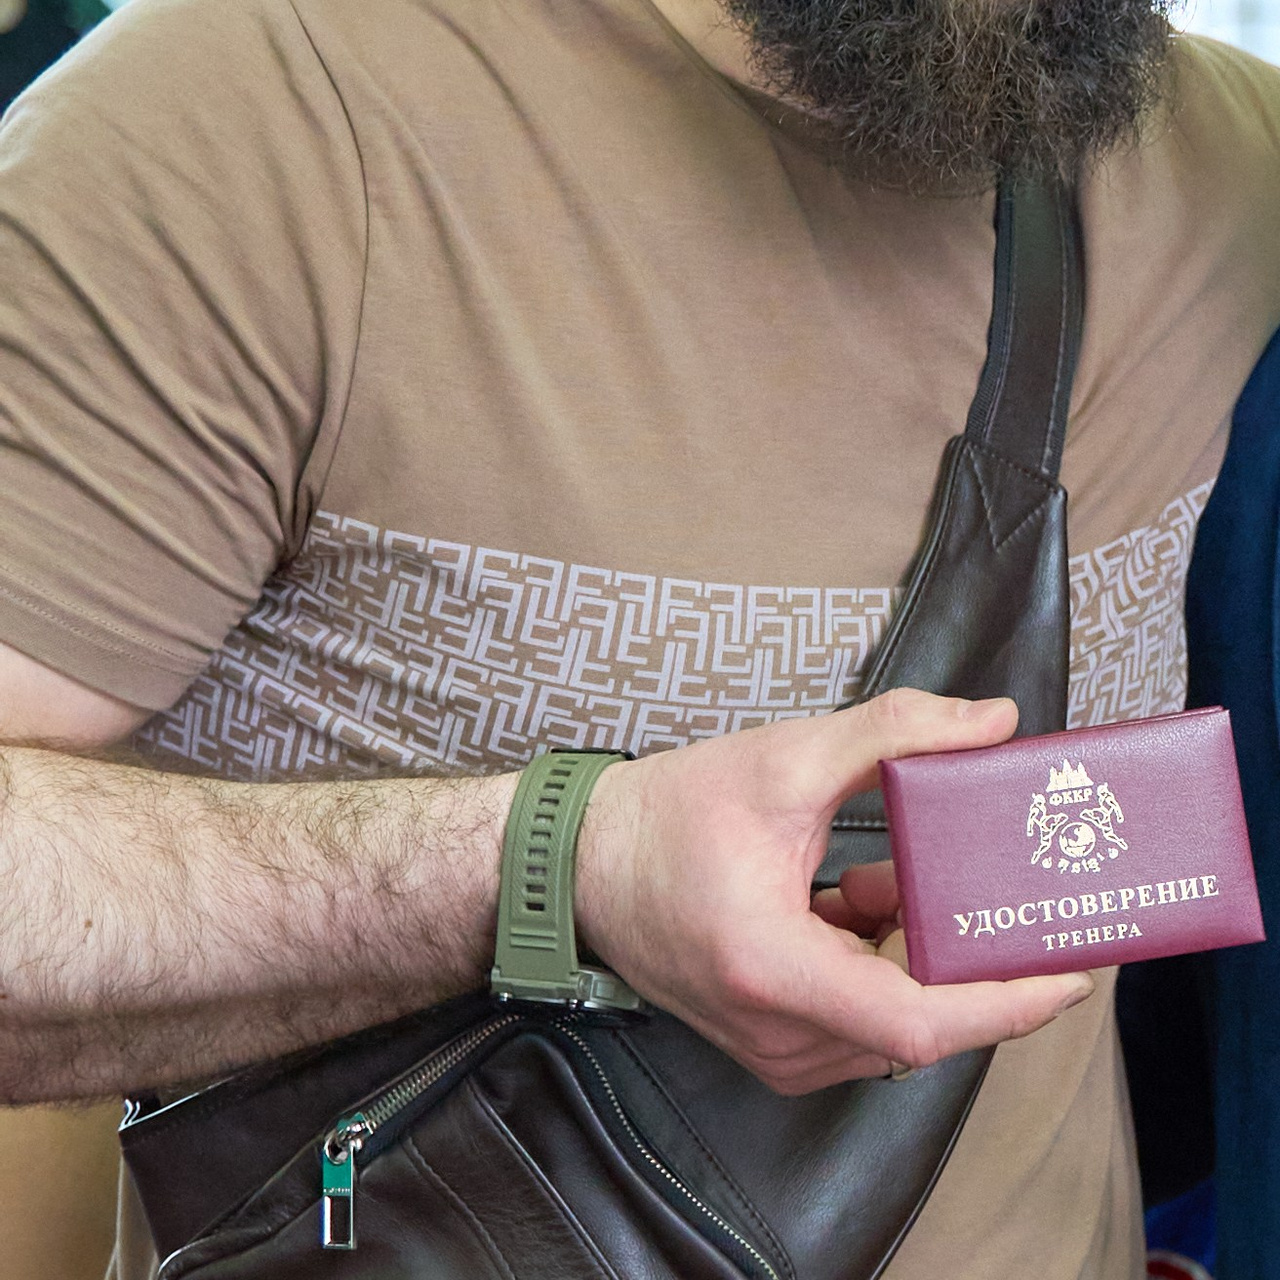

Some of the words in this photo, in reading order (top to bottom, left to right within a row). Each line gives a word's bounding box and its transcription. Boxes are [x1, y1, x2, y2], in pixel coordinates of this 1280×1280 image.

[1049, 788, 1093, 806] ФККР
[953, 875, 1219, 937] УДОСТОВЕРЕНИЕ
[1042, 922, 1143, 951] ТРЕНЕРА
